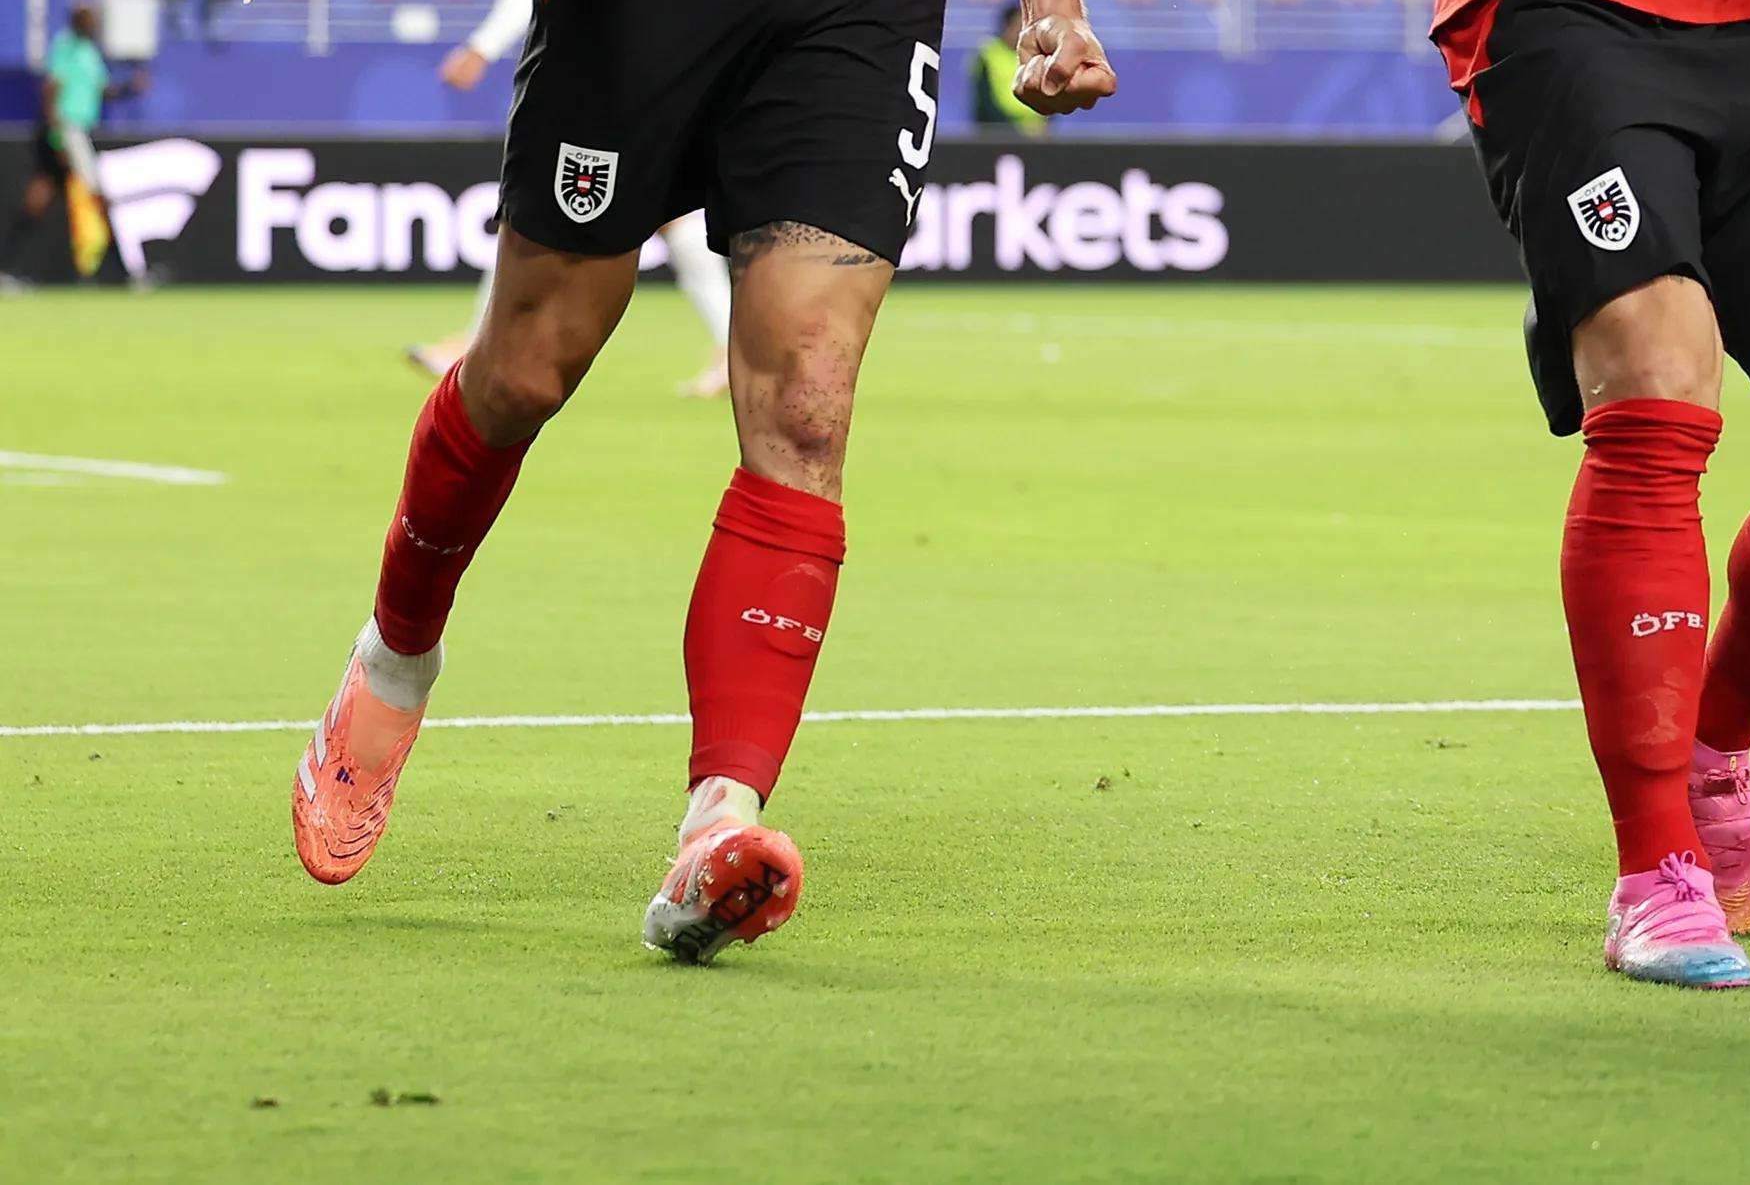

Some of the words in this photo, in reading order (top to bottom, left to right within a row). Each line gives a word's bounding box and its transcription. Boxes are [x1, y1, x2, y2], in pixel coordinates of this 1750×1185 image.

[899, 41, 940, 170] 5
[576, 152, 600, 163] ÖFB
[741, 607, 823, 642] ÖFB
[1630, 610, 1704, 637] ÖFB
